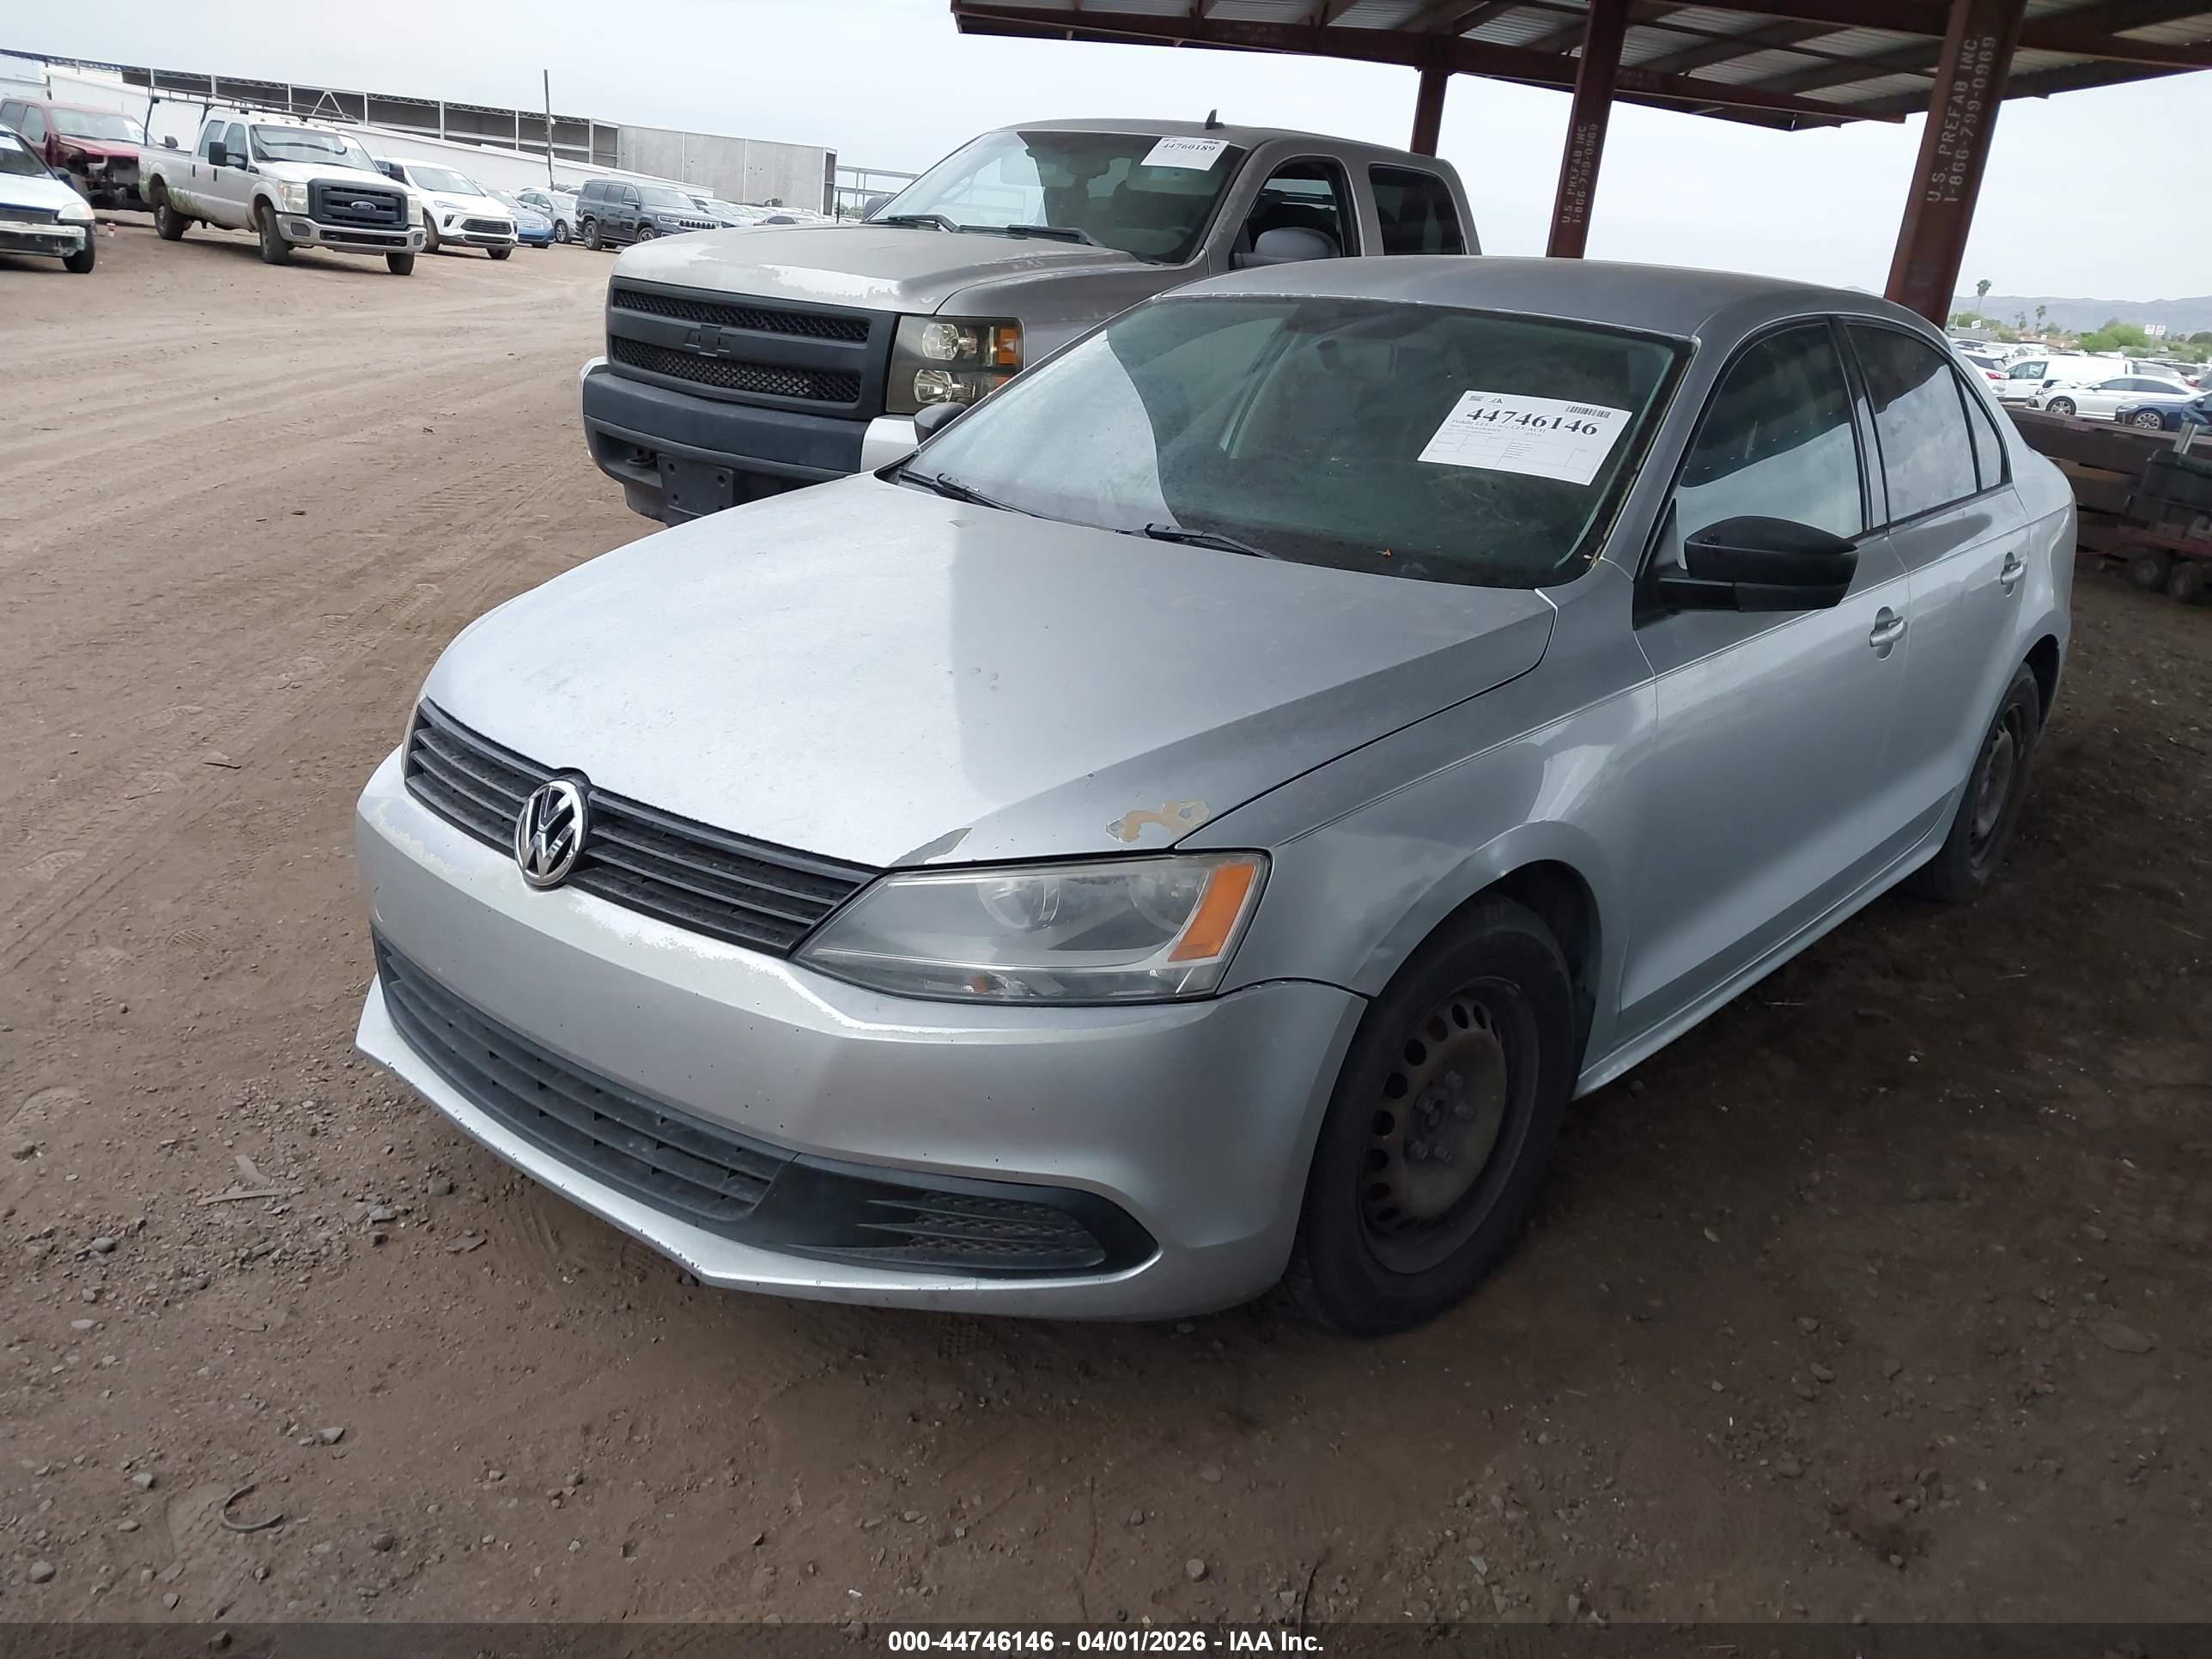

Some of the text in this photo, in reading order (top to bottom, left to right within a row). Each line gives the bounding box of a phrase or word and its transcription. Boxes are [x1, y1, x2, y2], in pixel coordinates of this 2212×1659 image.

[1926, 167, 1949, 202] U.S.
[1938, 80, 1969, 155] PREFAB
[1566, 149, 1583, 196] PREFAB
[1466, 408, 1601, 435] 44746146
